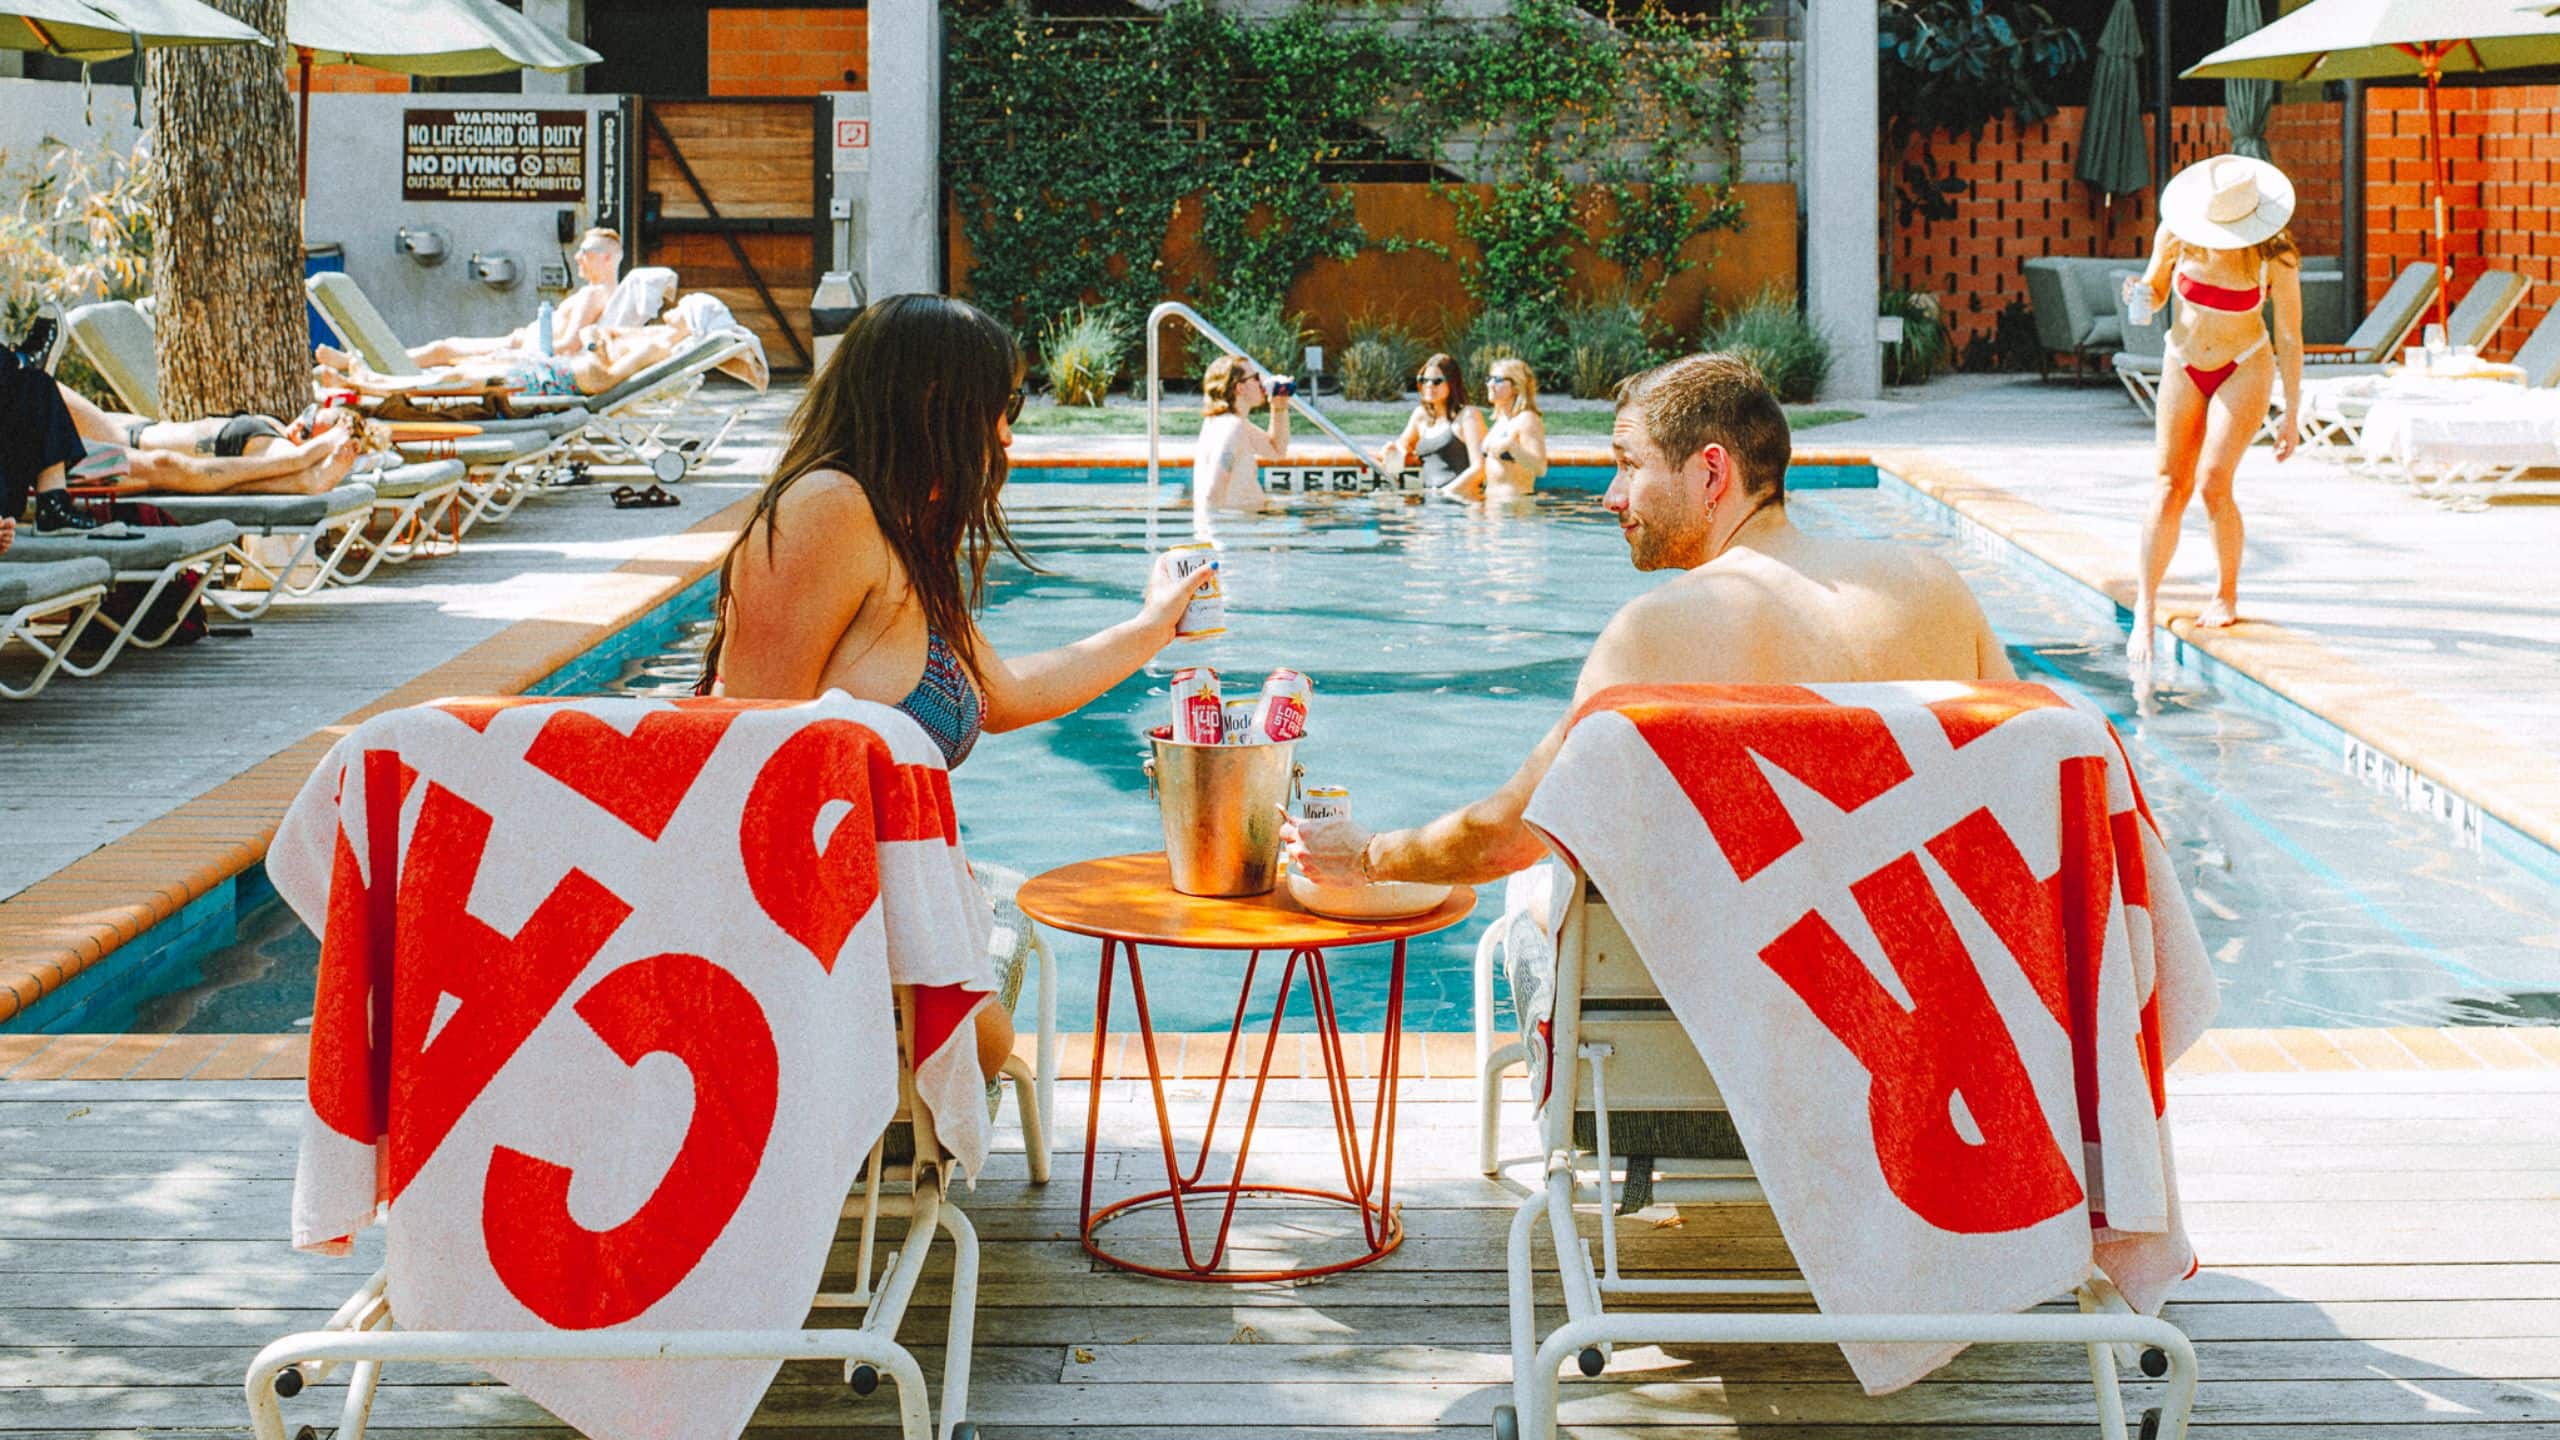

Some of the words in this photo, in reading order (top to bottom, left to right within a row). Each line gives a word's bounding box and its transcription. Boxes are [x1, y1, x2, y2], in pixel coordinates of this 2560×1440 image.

[454, 112, 537, 125] WARNING
[408, 125, 429, 146] NO
[433, 125, 513, 146] LIFEGUARD
[518, 125, 539, 146] ON
[543, 125, 583, 146] DUTY
[407, 155, 439, 174] NO
[442, 155, 517, 175] DIVING
[407, 176, 454, 189] OUTSIDE
[458, 176, 509, 189] ALCOHOL
[513, 176, 582, 191] PROHIBITED
[1191, 711, 1219, 727] 140
[1277, 704, 1304, 725] LONE
[1274, 715, 1300, 737] STAR
